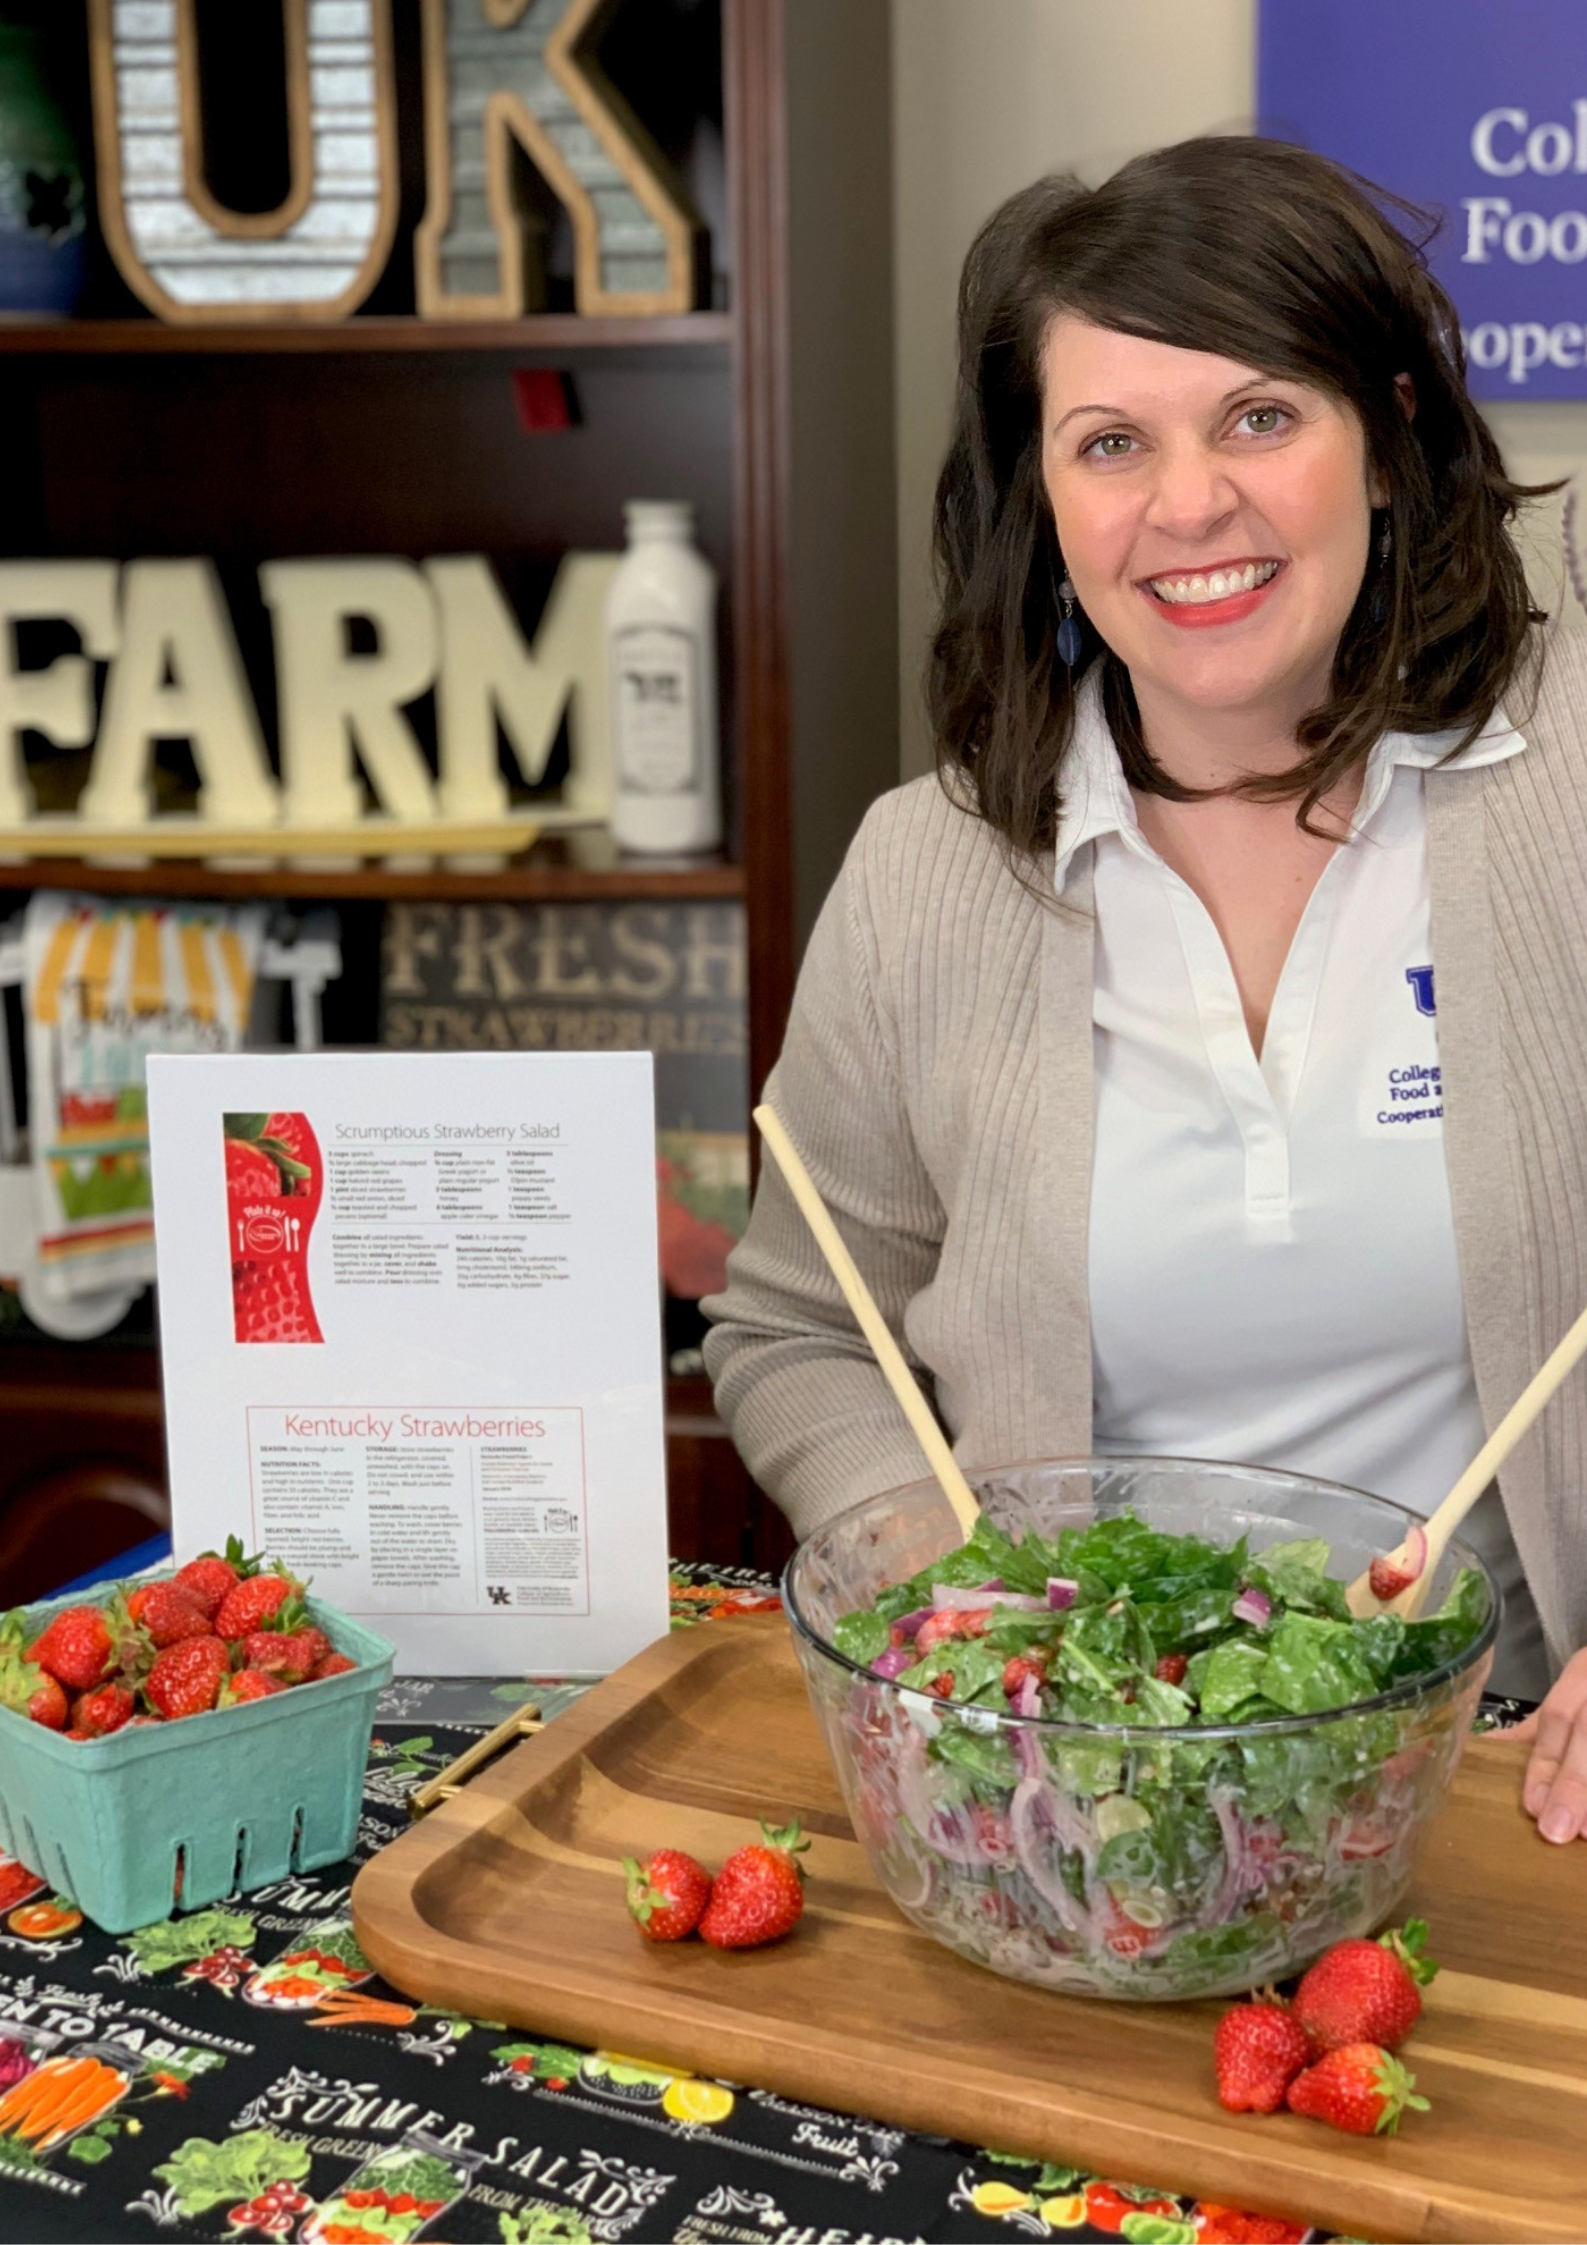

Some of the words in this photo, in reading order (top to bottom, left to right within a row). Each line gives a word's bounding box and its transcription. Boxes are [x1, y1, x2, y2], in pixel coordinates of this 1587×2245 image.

[0, 555, 618, 822] FARM
[386, 904, 746, 1001] FRESH
[1390, 1082, 1430, 1101] Food
[335, 1124, 430, 1141] Scrumptious
[434, 1124, 516, 1140] Strawberry
[520, 1123, 560, 1138] Salad
[285, 1413, 393, 1442] Kentucky
[400, 1413, 545, 1437] Strawberries
[487, 1586, 512, 1605] UK
[40, 2009, 96, 2036] TO
[99, 2022, 220, 2074] TABLE
[269, 2093, 476, 2151] SUMMER
[486, 2136, 630, 2217] SALAD
[792, 2122, 860, 2157] Fruit
[468, 2183, 523, 2211] FROM
